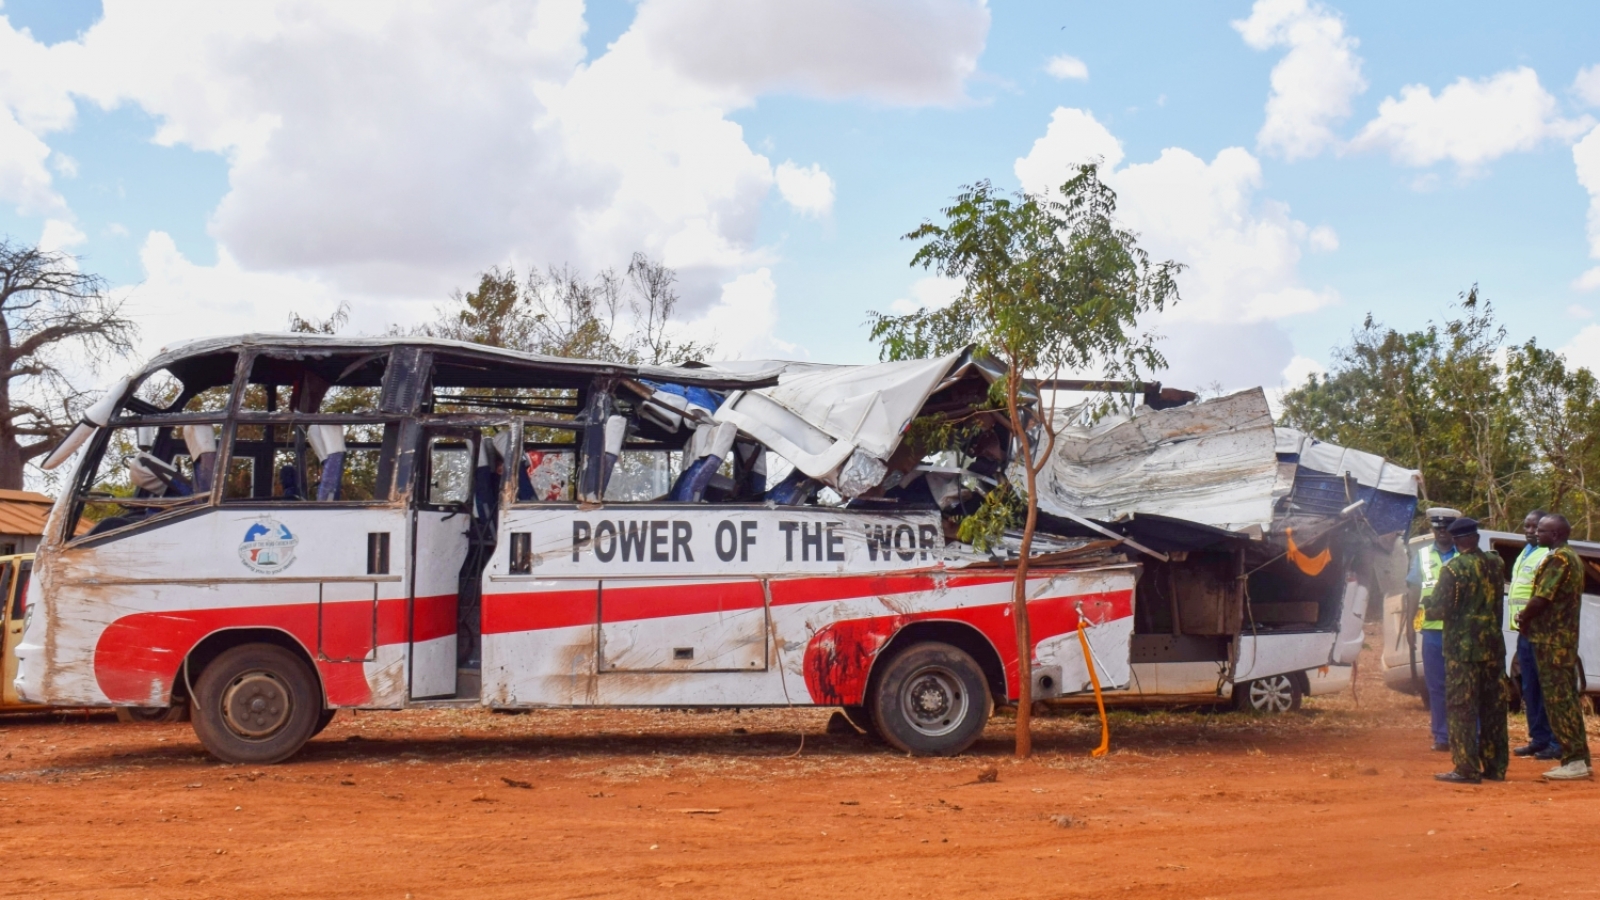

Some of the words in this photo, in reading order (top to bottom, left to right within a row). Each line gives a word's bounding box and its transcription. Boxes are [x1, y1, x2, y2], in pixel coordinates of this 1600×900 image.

[572, 520, 695, 563] POWER
[715, 520, 757, 562] OF
[779, 520, 845, 562] THE
[864, 523, 961, 561] WOR
